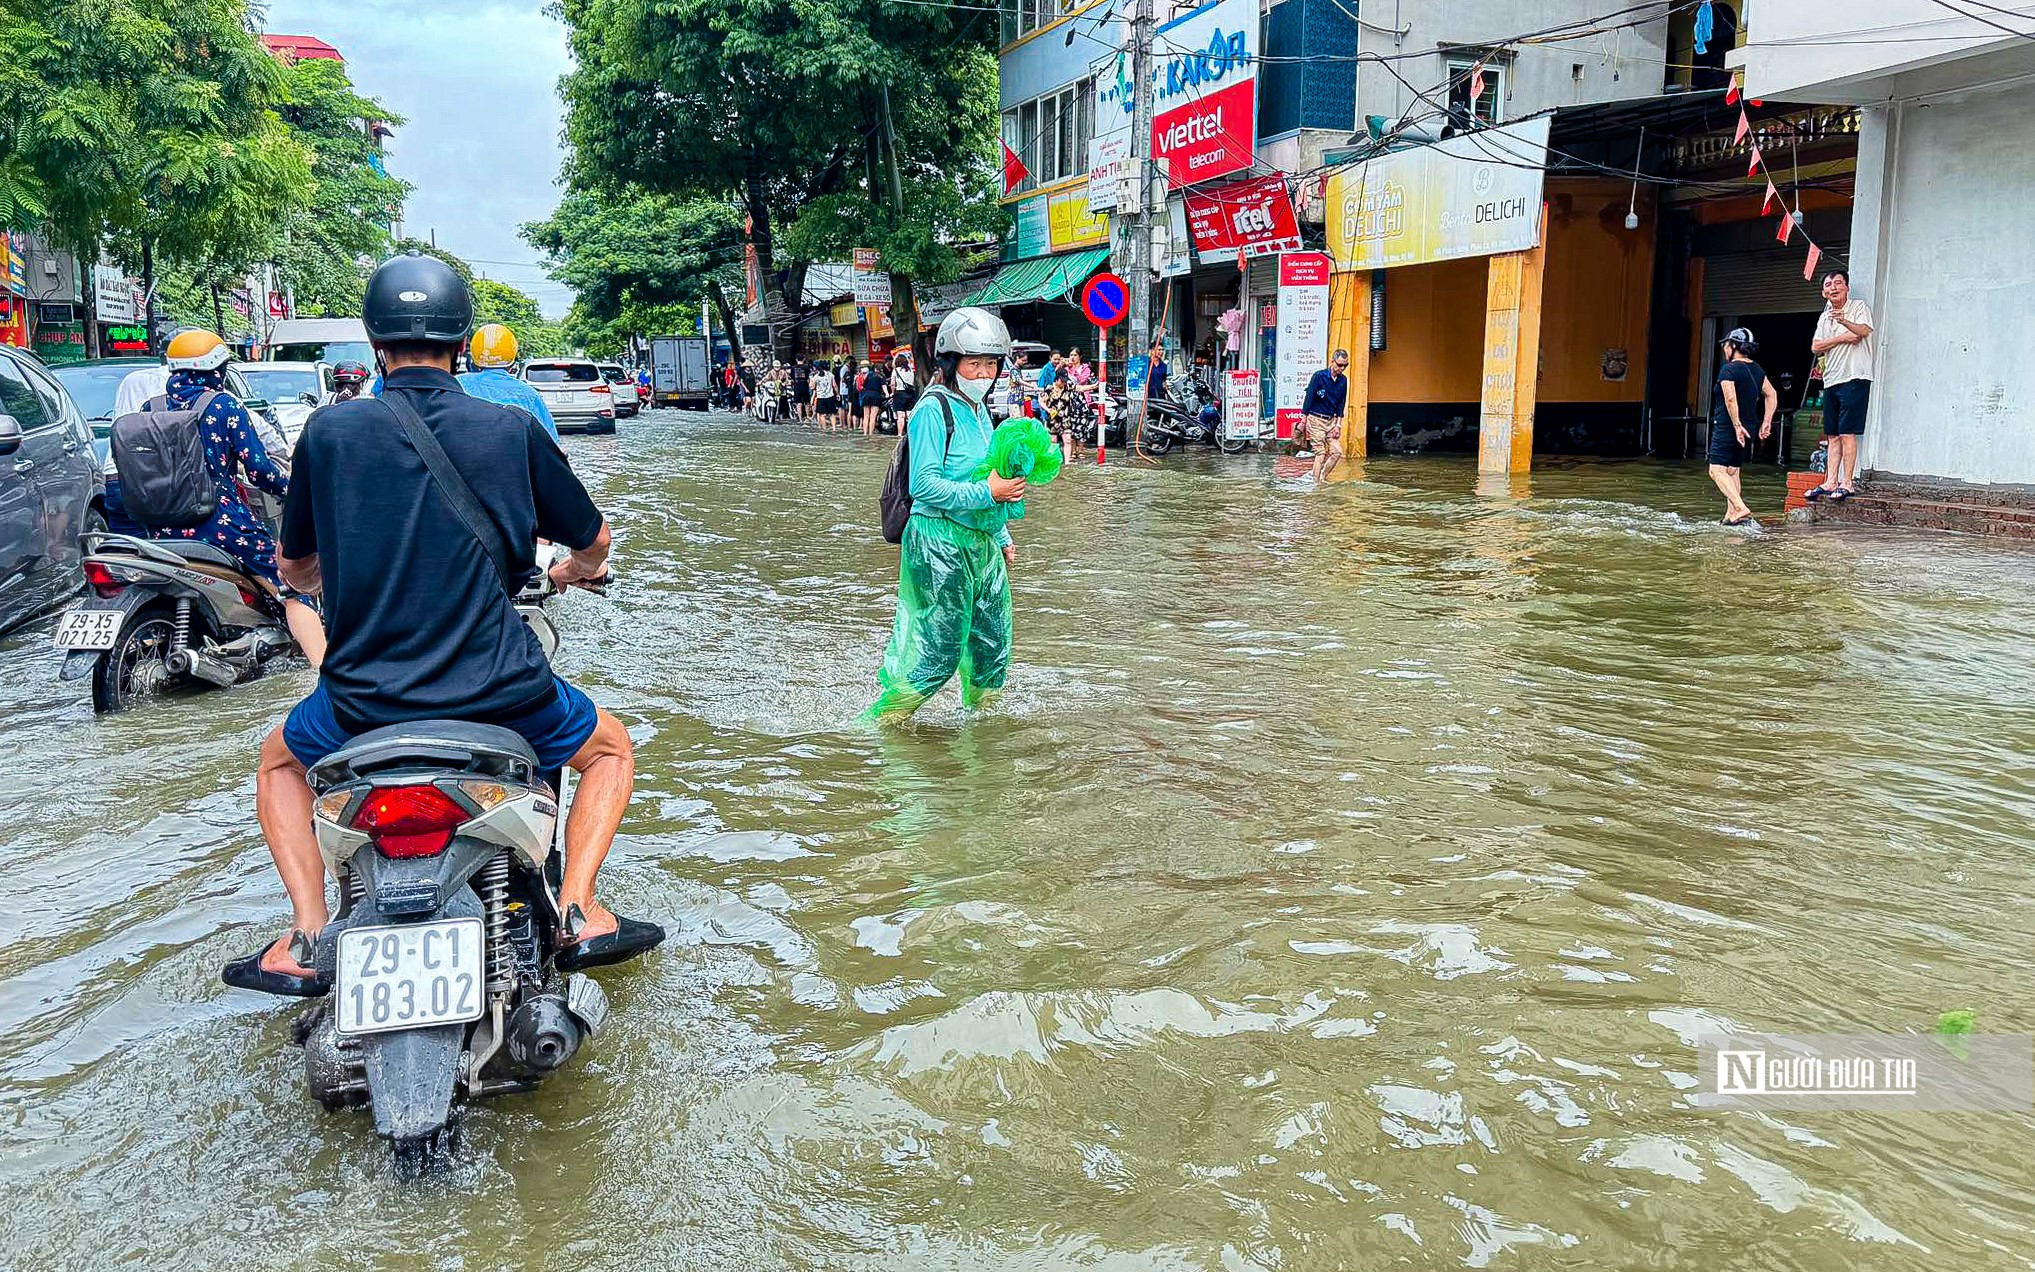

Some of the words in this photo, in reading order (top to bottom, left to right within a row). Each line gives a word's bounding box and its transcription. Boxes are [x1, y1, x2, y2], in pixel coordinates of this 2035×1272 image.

[1158, 106, 1225, 154] viettel
[1188, 148, 1225, 170] telecom
[1090, 164, 1108, 182] ANH
[1475, 197, 1526, 224] DELICHI
[1345, 209, 1403, 240] DELICHI
[69, 614, 115, 629] 29-X5
[58, 630, 113, 646] 021.25
[360, 927, 460, 978] 29-C1
[350, 972, 474, 1026] 183.02
